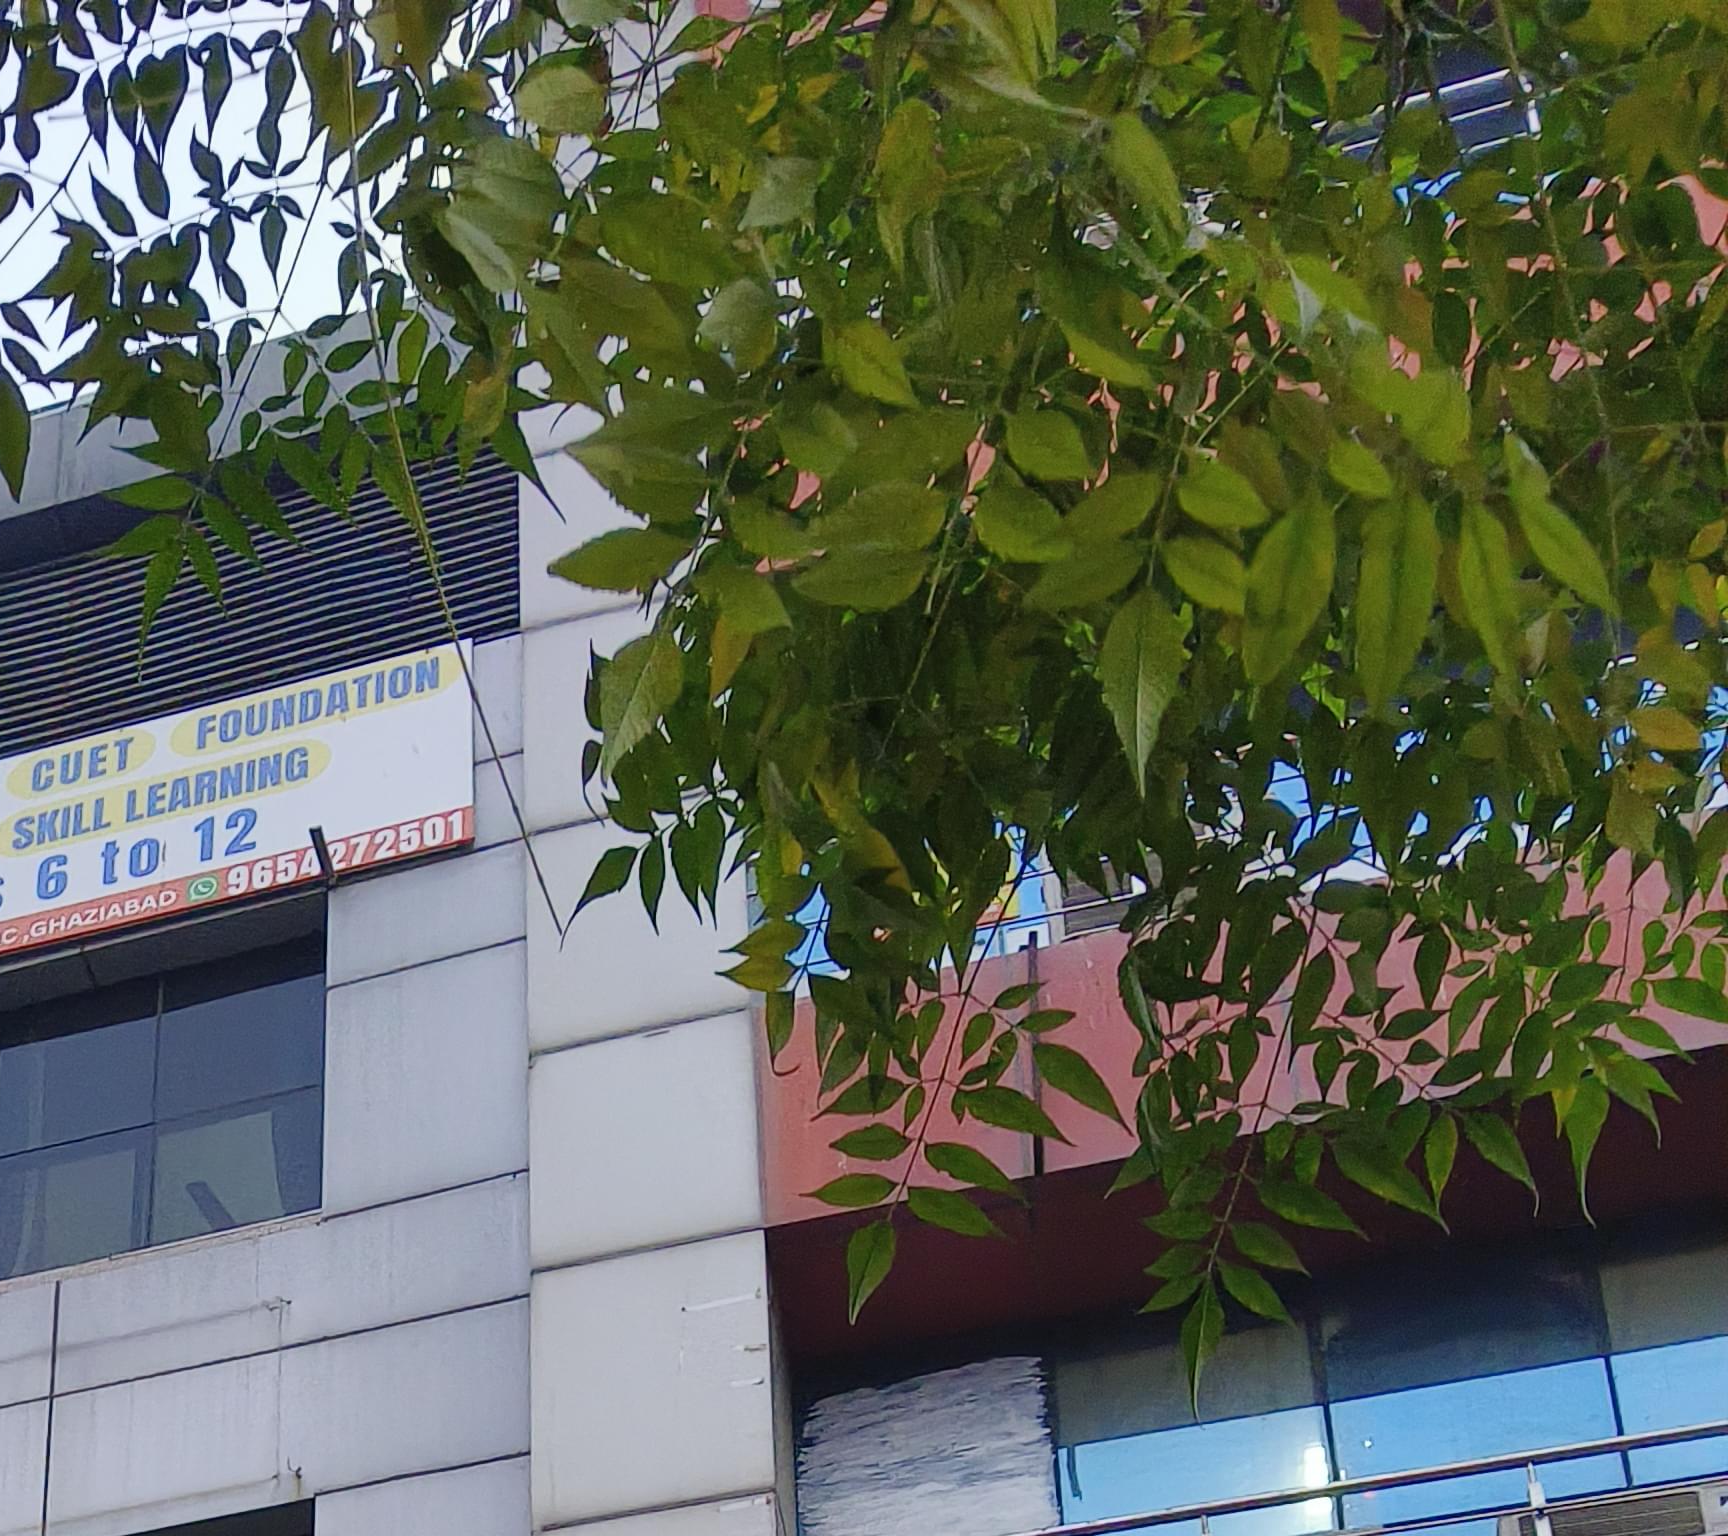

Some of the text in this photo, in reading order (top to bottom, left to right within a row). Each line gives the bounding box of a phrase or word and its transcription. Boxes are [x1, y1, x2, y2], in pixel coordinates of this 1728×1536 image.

[30, 735, 134, 793] CUET
[195, 655, 441, 750] FOUNDATION
[12, 796, 112, 852] SKILL
[124, 746, 310, 823] LEARNING
[35, 853, 70, 900] 6
[100, 837, 162, 886] to
[193, 807, 258, 862] 12
[226, 810, 464, 896] 9654272501
